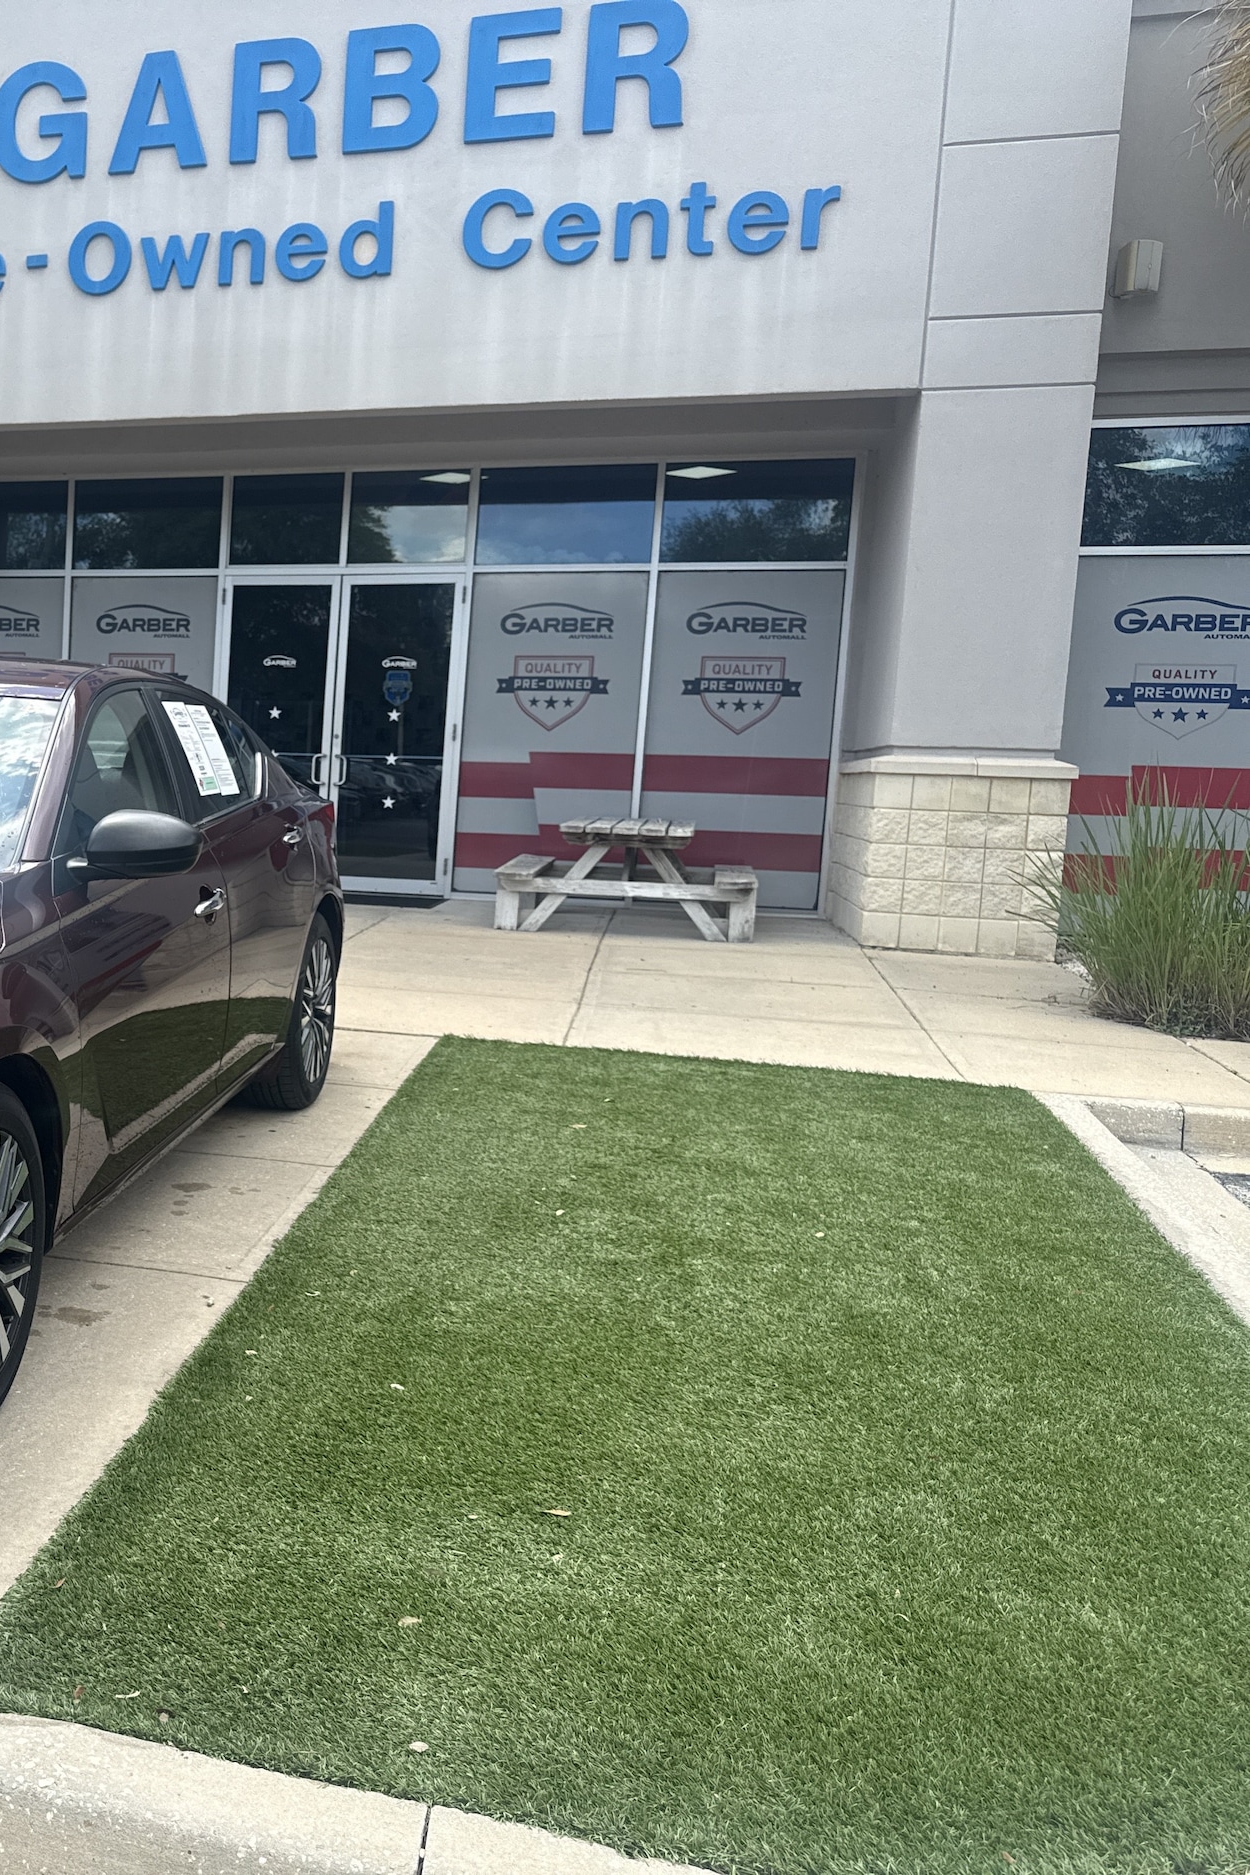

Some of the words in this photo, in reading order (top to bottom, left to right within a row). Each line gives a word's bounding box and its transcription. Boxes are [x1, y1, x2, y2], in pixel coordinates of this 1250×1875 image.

[462, 181, 842, 270] Center
[96, 613, 190, 634] GARBER
[500, 612, 614, 635] GARBER
[686, 612, 807, 635] GARBER
[525, 662, 582, 674] QUALITY
[712, 663, 773, 675] QUALITY
[1152, 669, 1218, 679] QUALITY
[513, 679, 592, 690] PRE-OWNED
[700, 681, 783, 692] PRE-OWNED
[1133, 686, 1232, 700] PRE-OWNED
